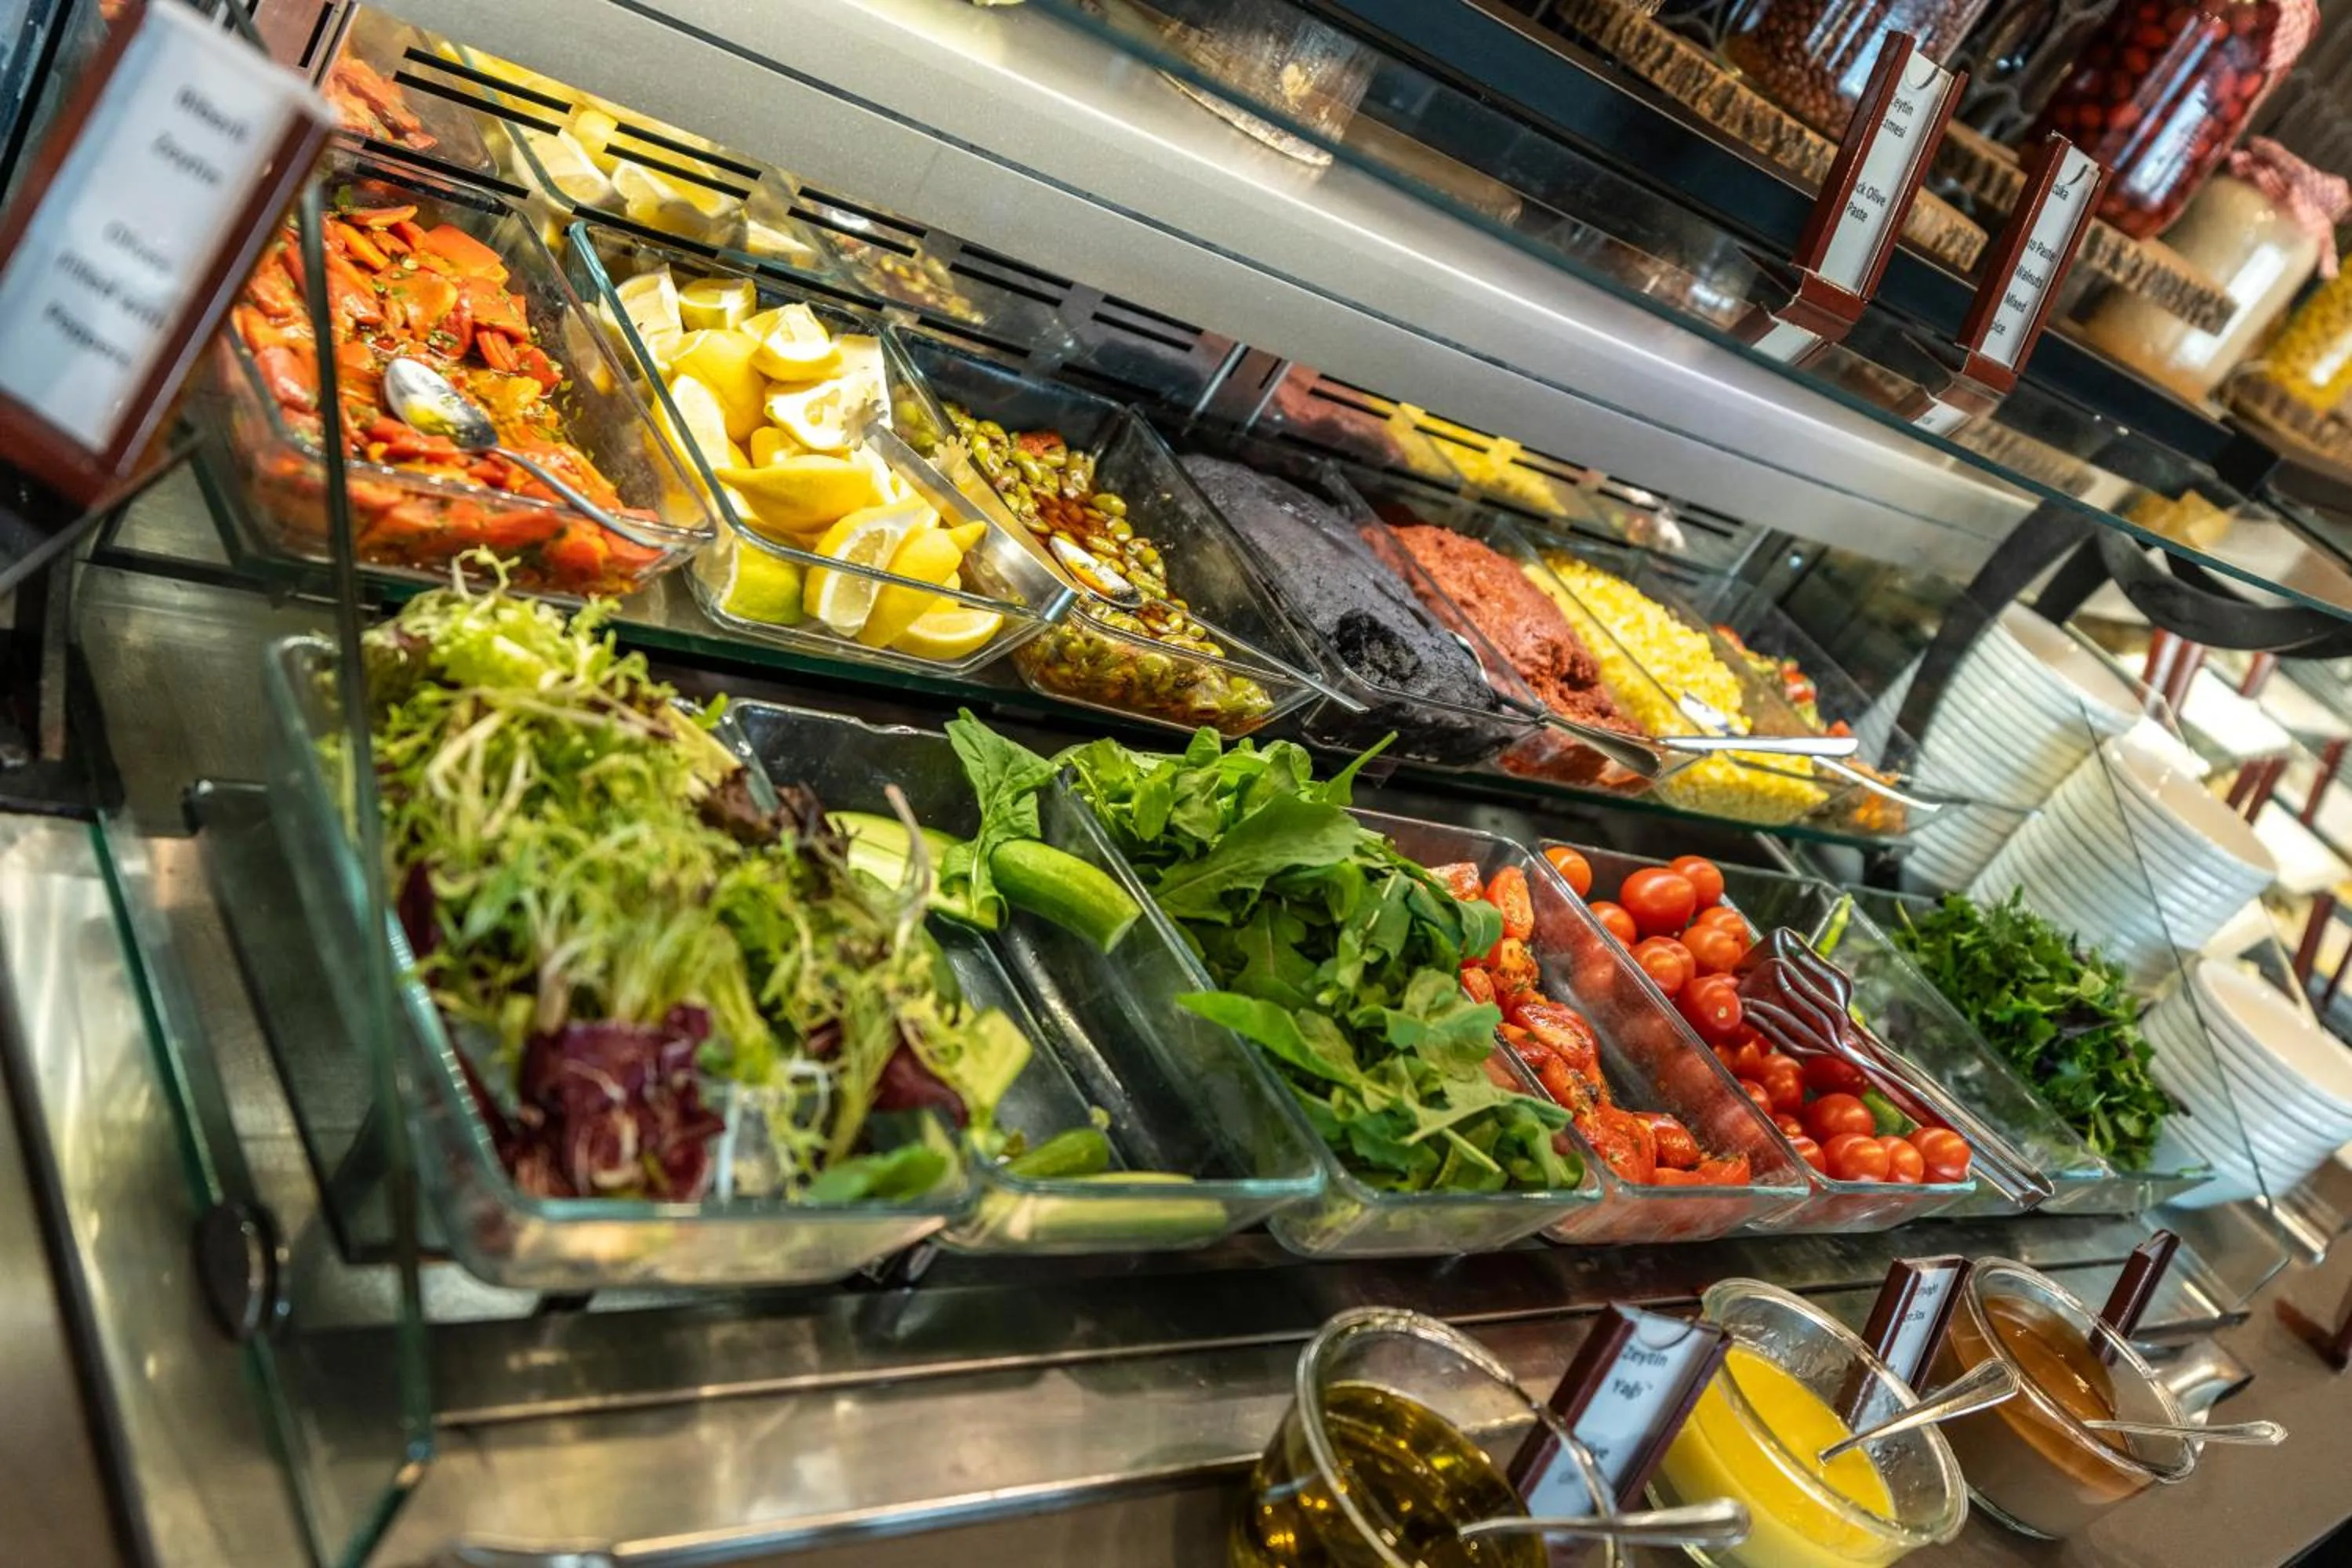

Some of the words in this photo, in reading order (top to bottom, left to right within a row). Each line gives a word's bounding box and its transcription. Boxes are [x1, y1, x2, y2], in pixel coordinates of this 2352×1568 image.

[1892, 97, 1914, 117] eytin
[152, 130, 223, 186] Zeytin
[1867, 186, 1886, 207] Olive
[1846, 201, 1868, 223] Paste
[1622, 1345, 1668, 1368] Zeytin
